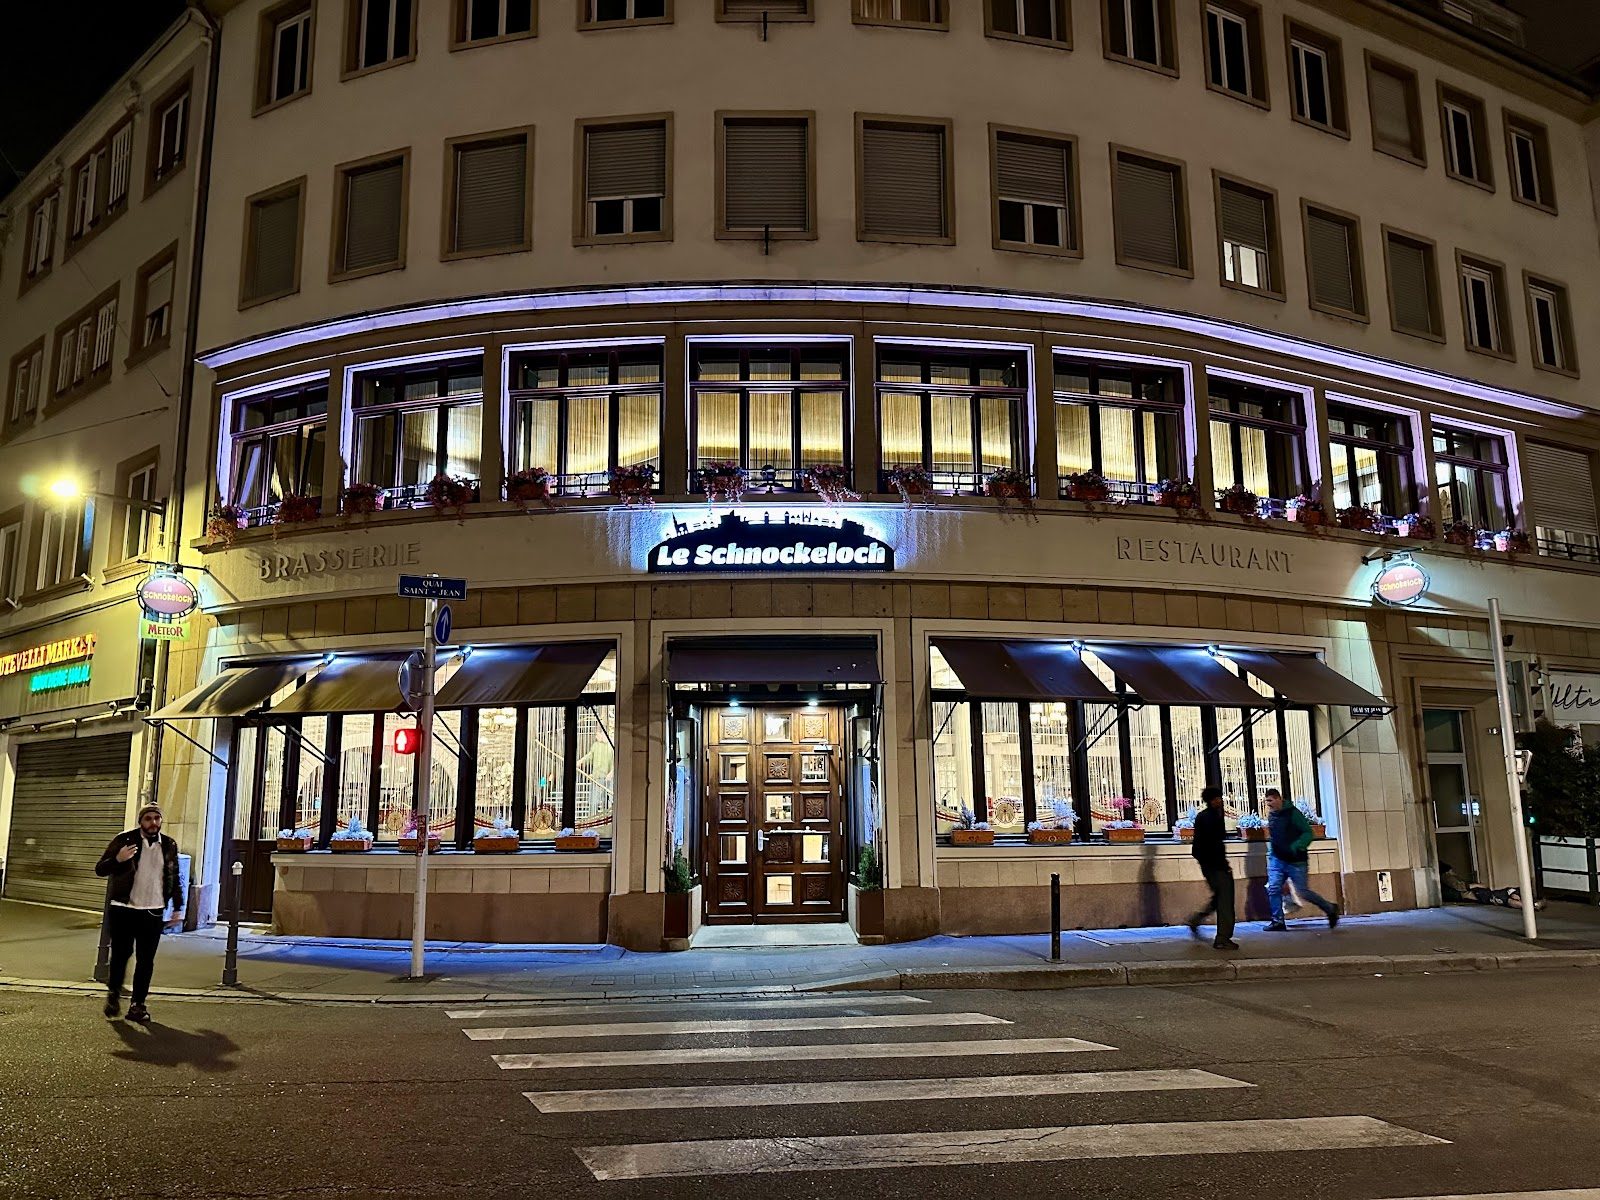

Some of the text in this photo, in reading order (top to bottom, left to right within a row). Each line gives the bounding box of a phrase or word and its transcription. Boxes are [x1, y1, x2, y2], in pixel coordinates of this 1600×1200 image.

[258, 541, 421, 580] BRASSERIE
[656, 541, 886, 566] Le Schnockeloch
[1116, 535, 1295, 574] RESTAURANT
[404, 587, 429, 595] SAINT
[438, 589, 460, 597] JEAN
[422, 580, 443, 588] QUAI
[147, 624, 184, 637] METEOR
[45, 633, 95, 666] MARKET
